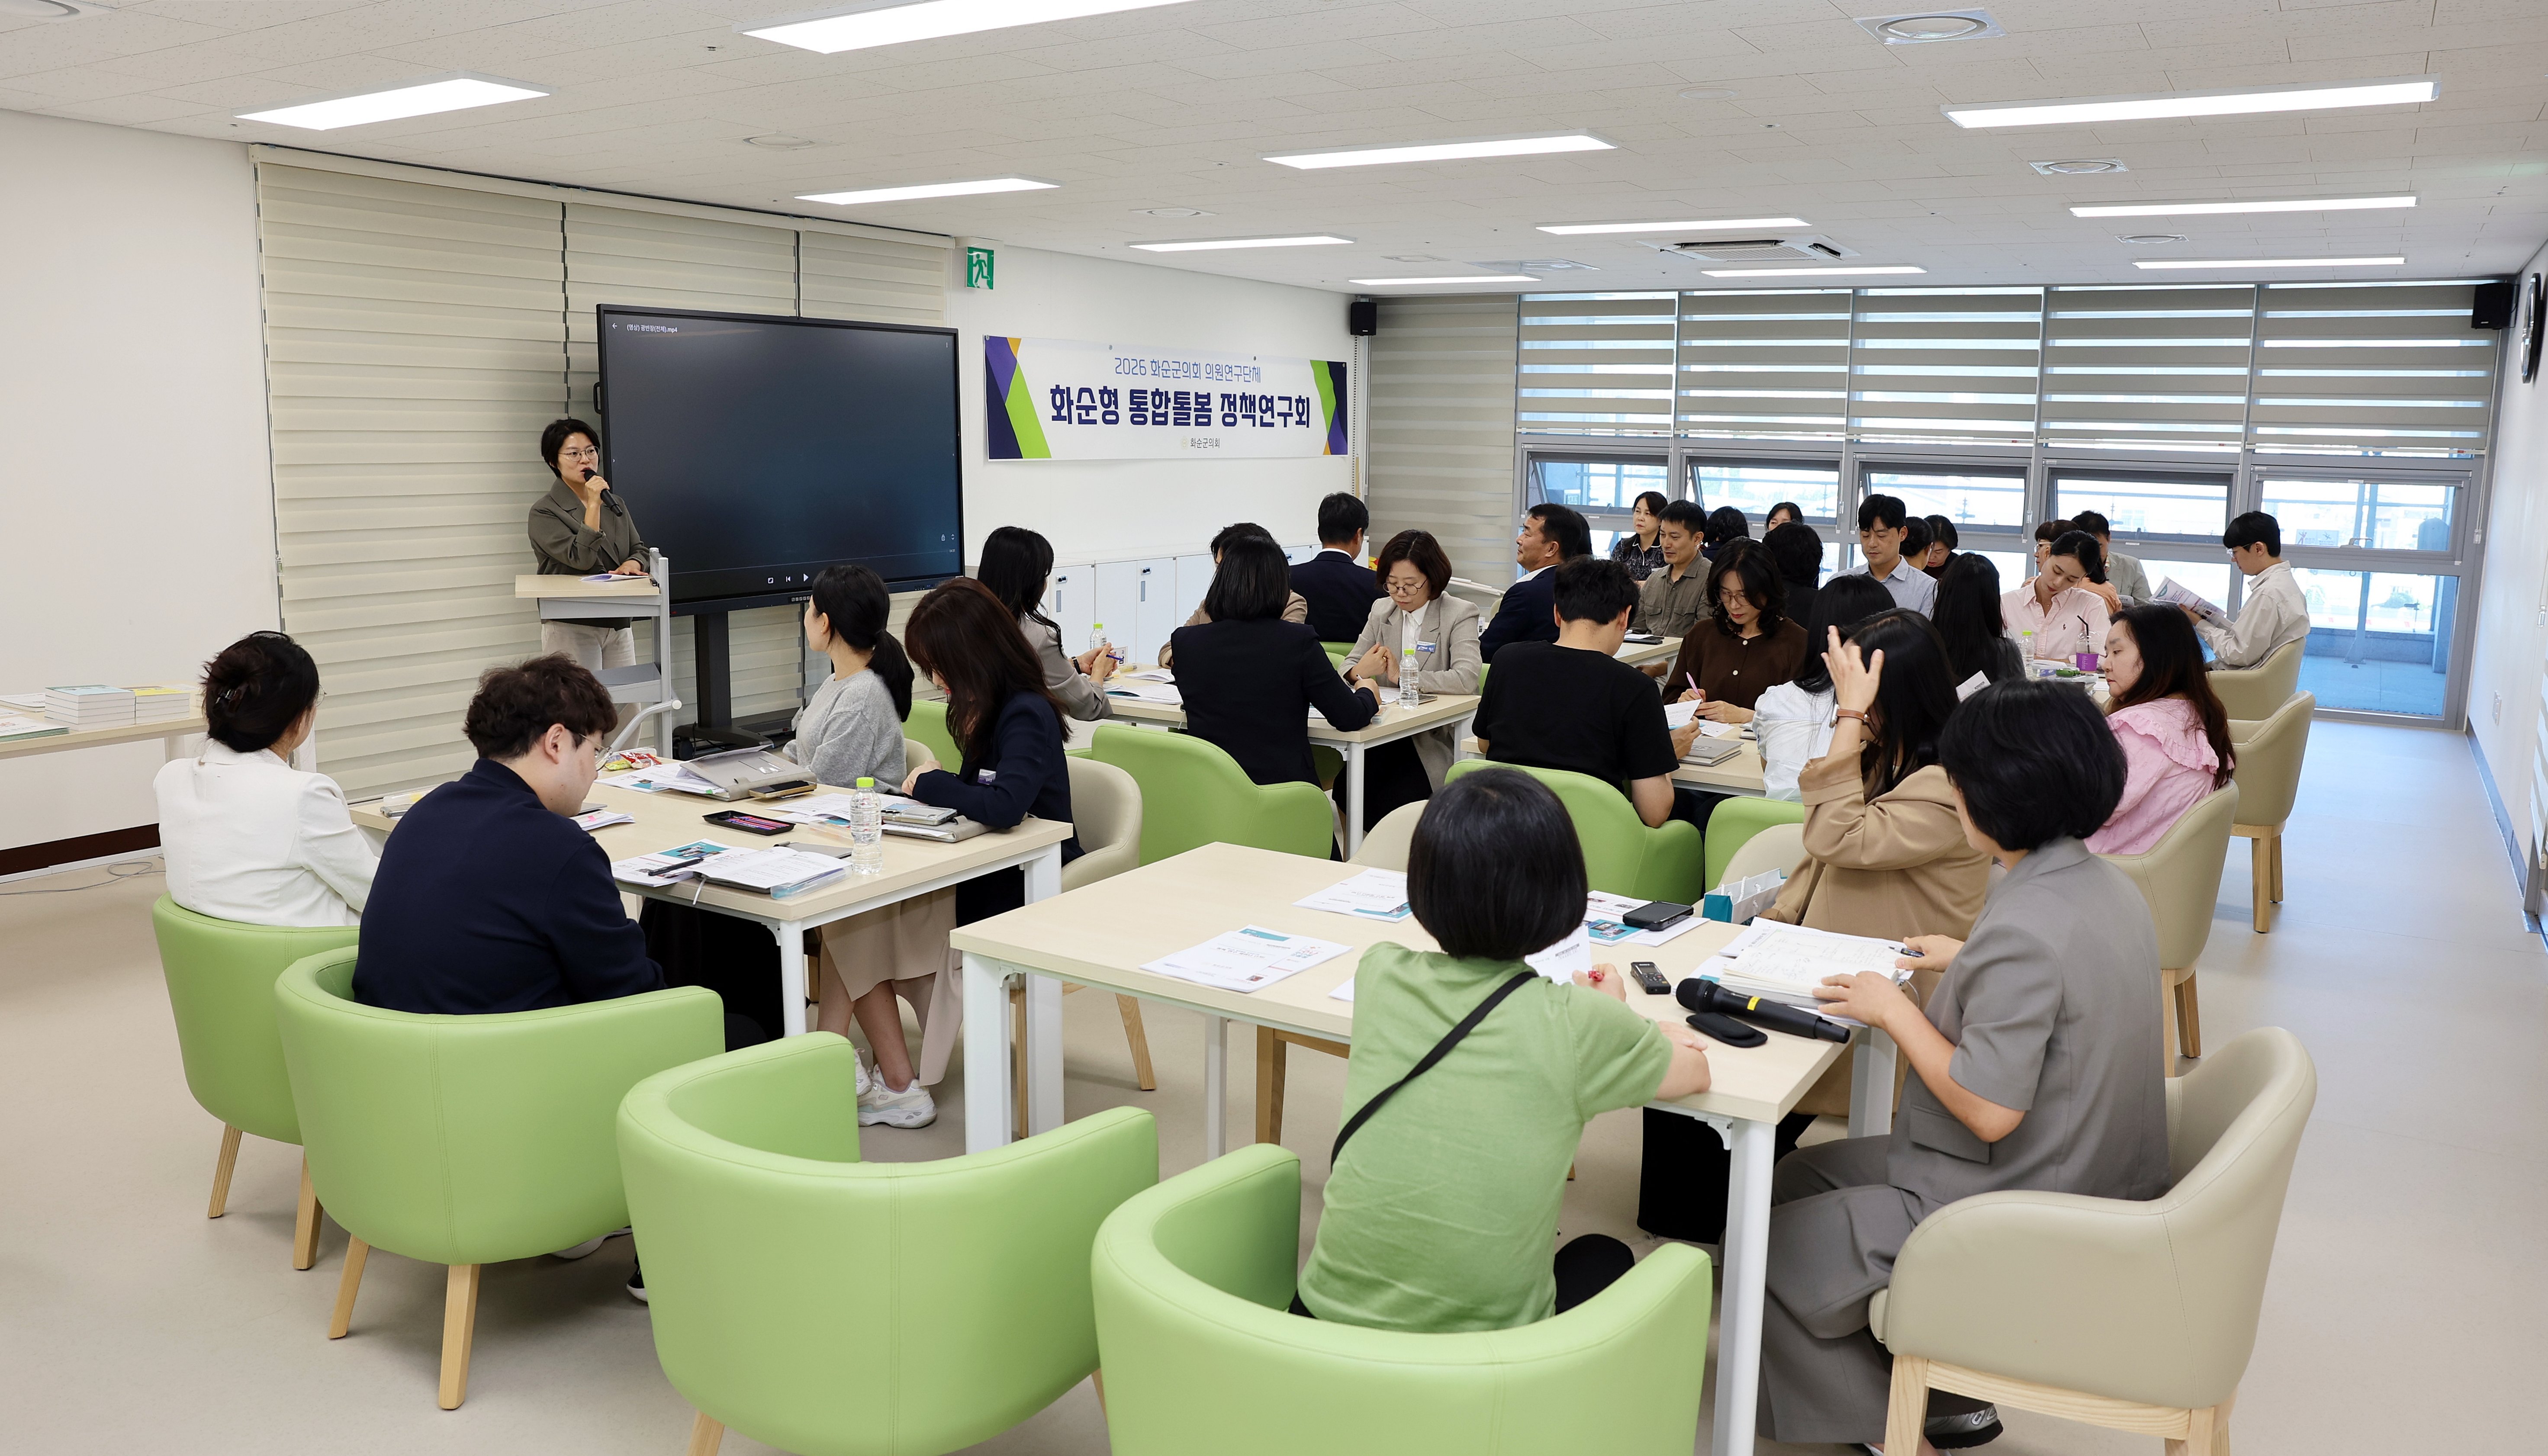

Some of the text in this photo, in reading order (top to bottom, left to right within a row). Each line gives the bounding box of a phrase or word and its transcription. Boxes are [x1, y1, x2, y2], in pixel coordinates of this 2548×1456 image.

[1115, 357, 1261, 383] 2026 화순군의회 의원연구단체
[1050, 384, 1120, 425] 화순형
[1220, 392, 1310, 428] 정책연구회
[1190, 438, 1220, 448] 화순군의회
